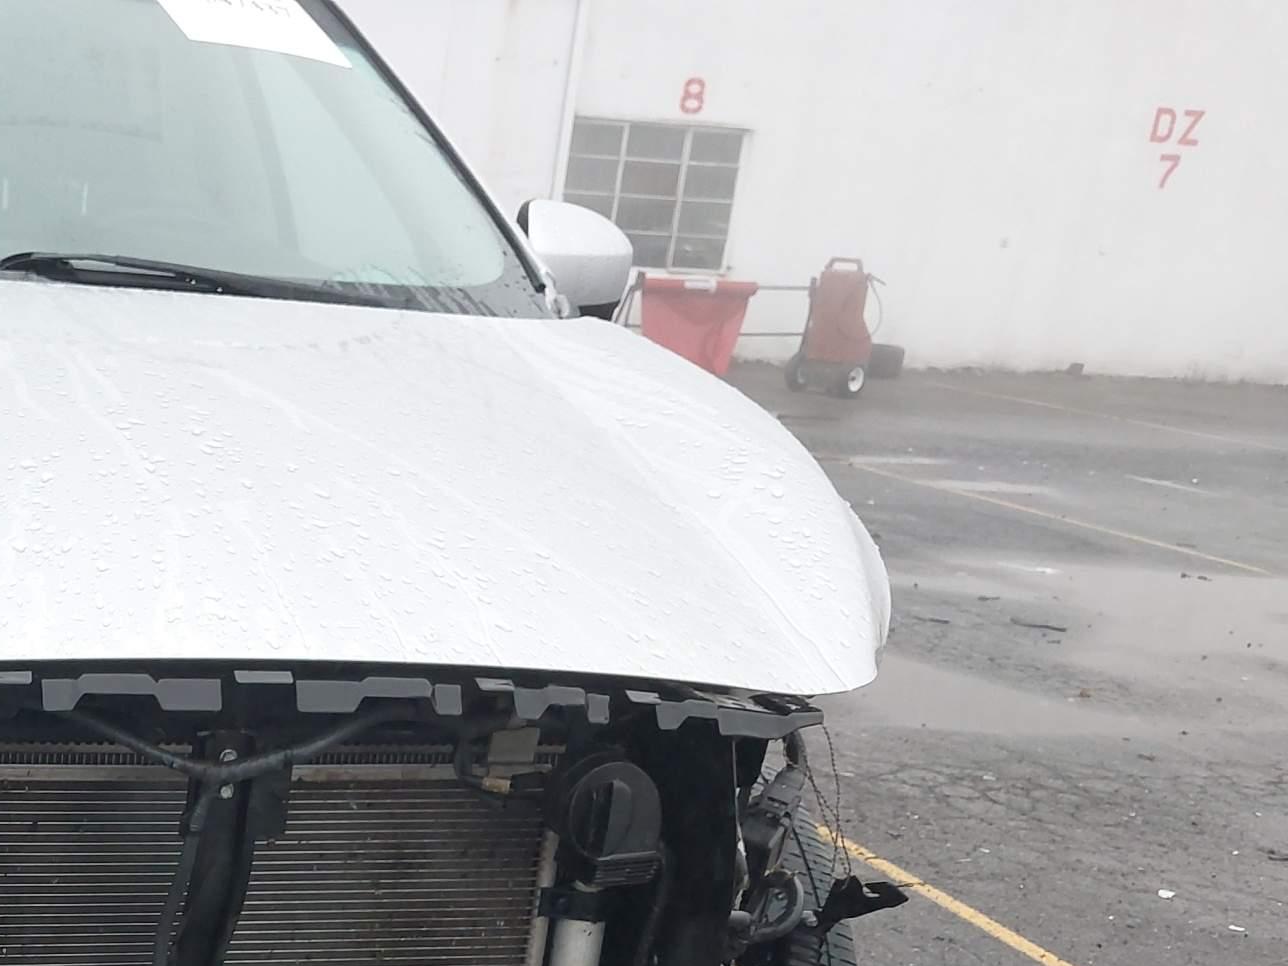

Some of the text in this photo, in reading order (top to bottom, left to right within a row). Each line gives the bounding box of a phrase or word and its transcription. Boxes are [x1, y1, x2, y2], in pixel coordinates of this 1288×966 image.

[680, 78, 706, 114] 8
[1150, 107, 1205, 146] DZ
[1159, 154, 1181, 189] 7
